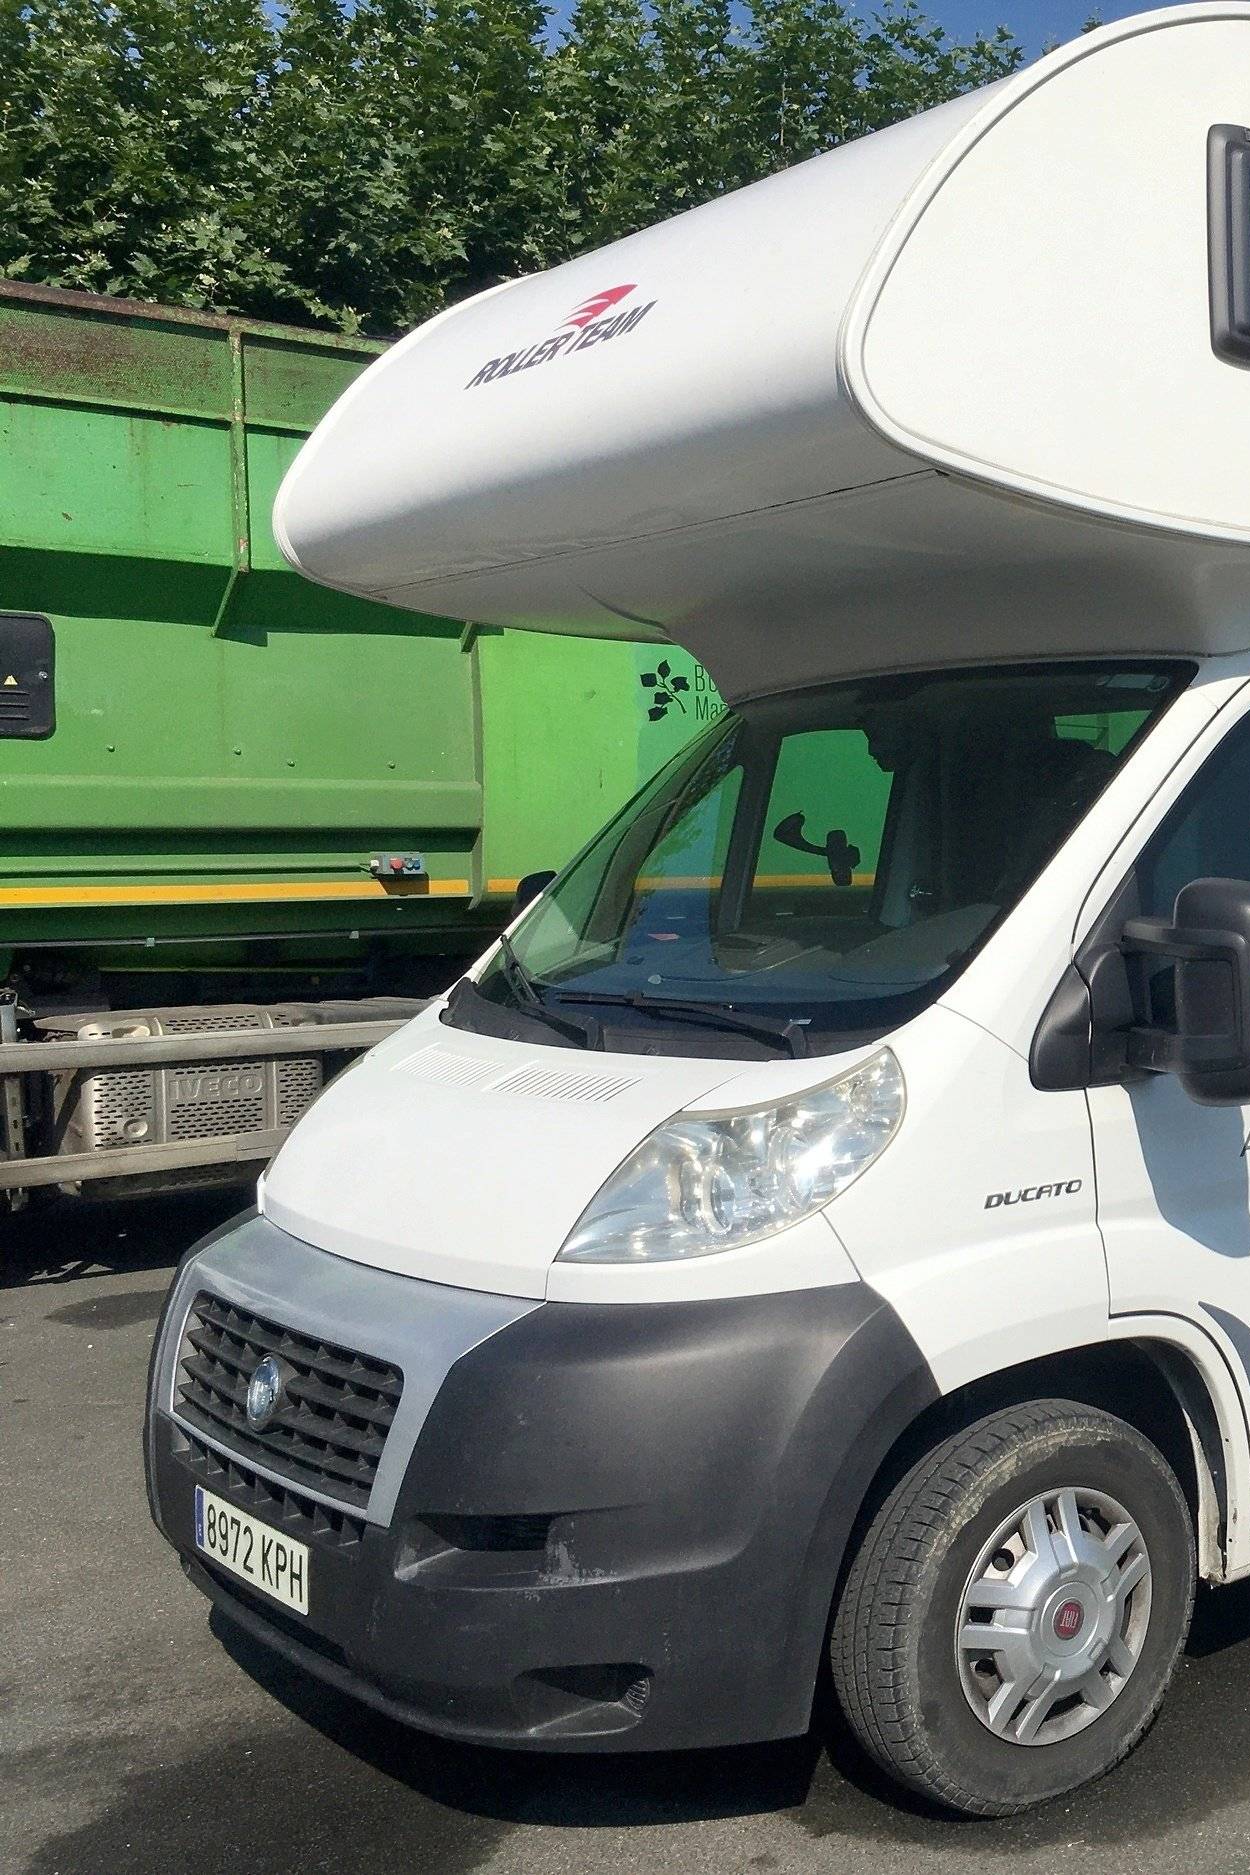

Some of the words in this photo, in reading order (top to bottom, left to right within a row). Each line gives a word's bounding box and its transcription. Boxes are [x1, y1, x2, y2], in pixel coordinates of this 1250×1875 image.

[464, 331, 575, 390] ROLLER
[564, 300, 658, 356] TEAM
[169, 1073, 263, 1100] IVECO
[984, 1179, 1082, 1210] DUCATO
[207, 1503, 254, 1575] 8972
[261, 1534, 303, 1603] KPH
